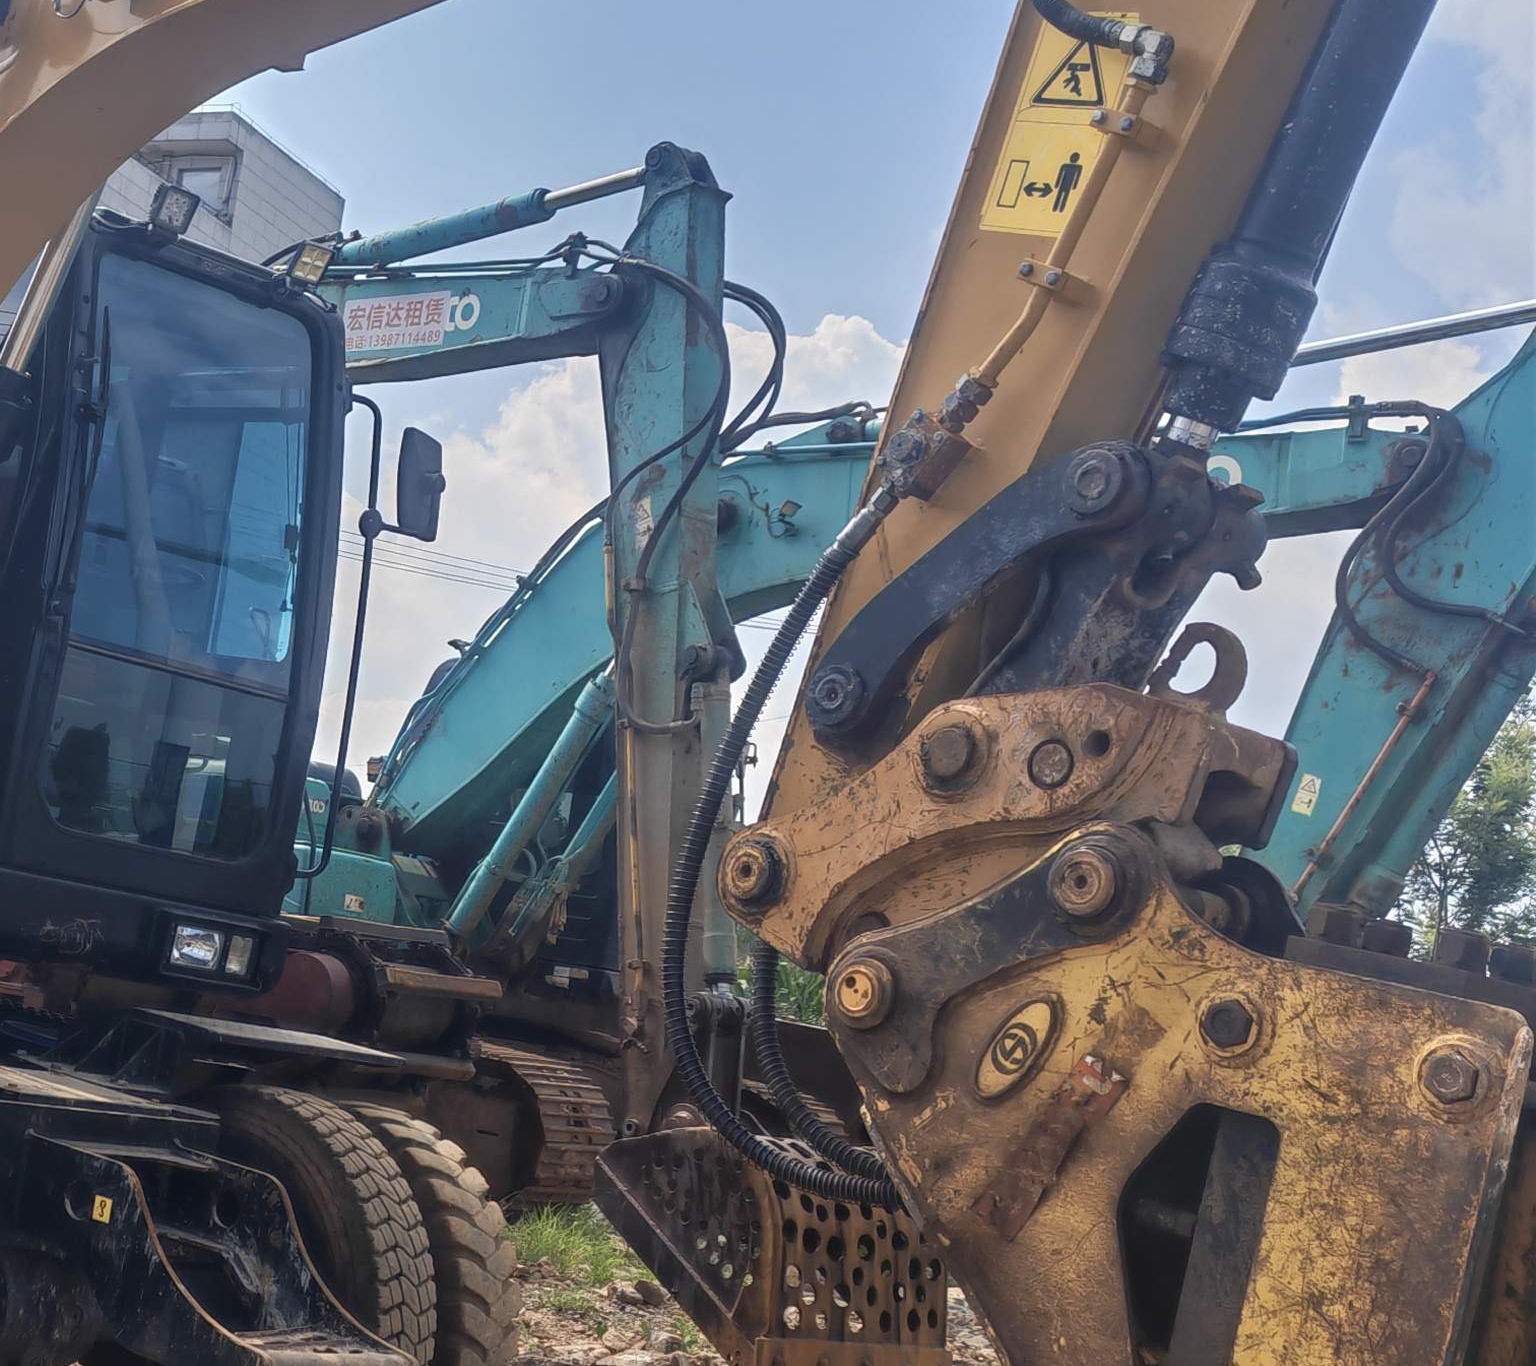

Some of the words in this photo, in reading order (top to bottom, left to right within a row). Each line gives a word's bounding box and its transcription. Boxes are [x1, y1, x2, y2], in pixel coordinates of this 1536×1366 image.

[347, 297, 445, 332] 宏信达租赁
